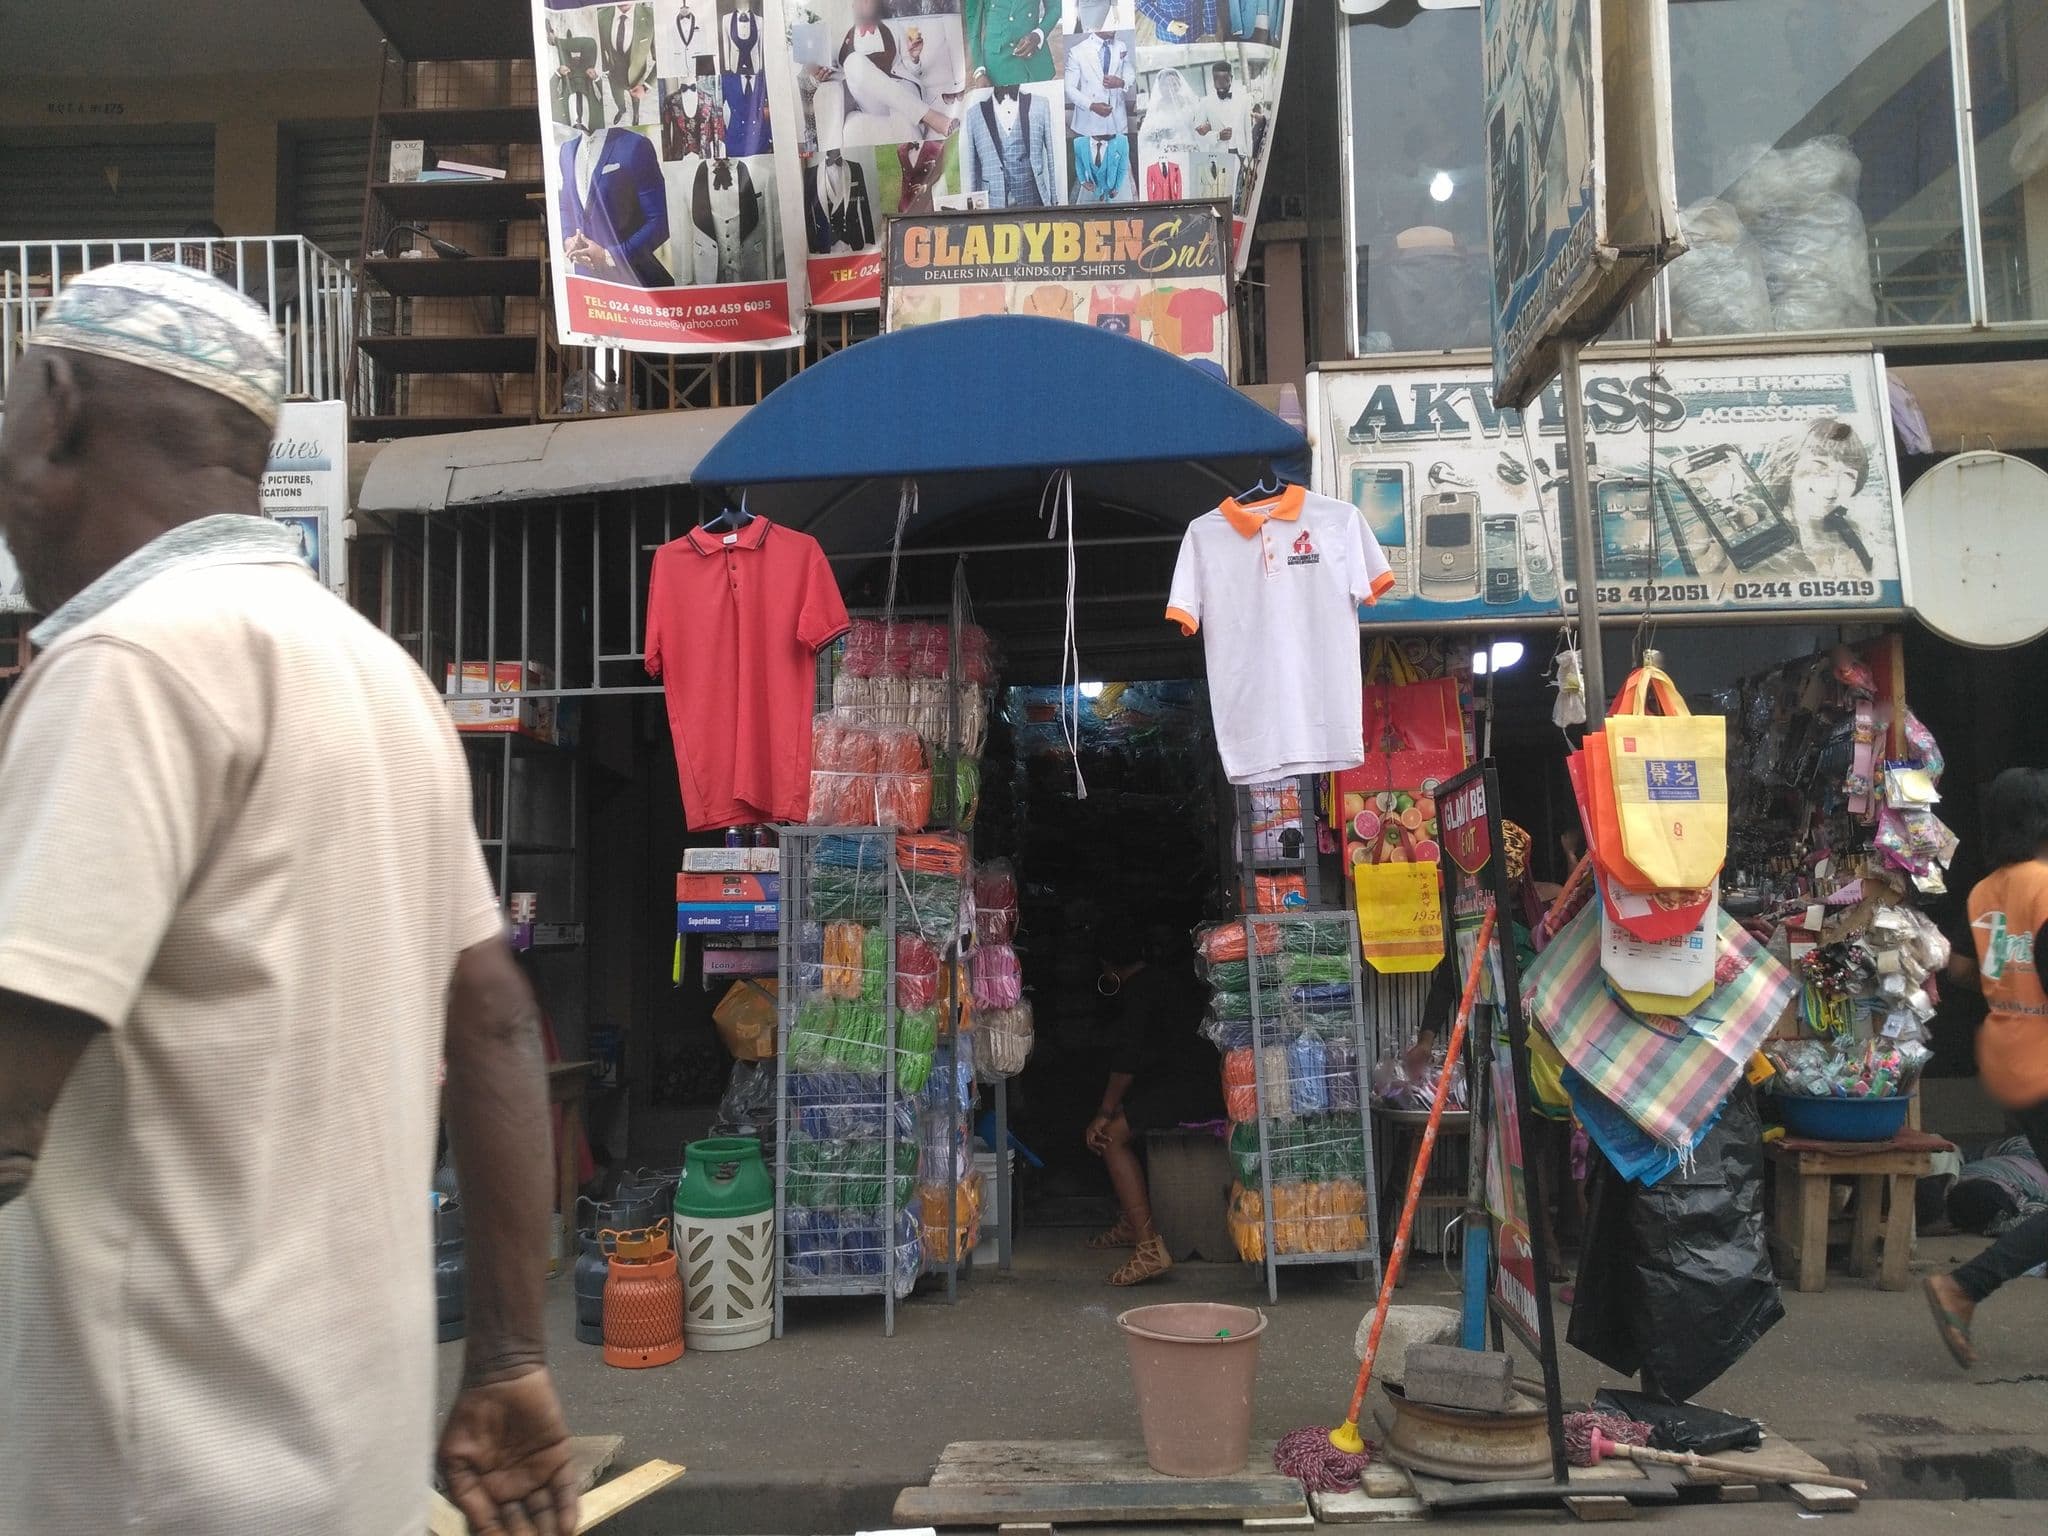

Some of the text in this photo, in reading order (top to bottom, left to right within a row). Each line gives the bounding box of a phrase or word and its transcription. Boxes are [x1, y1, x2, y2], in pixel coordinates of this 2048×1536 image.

[903, 219, 1144, 268] GLADYBEN
[830, 268, 857, 281] TEL:
[924, 264, 1126, 280] DEALERS IN ALL KINDS OF T-SHIRTS
[584, 295, 771, 317] TEL: 024 498 5878 / 024 459 6095
[588, 308, 739, 332] EMAIL: wastaee@yahoo.com
[1675, 374, 1848, 395] MOBILE PHONES
[1767, 391, 1784, 405] &
[1700, 404, 1840, 425] ACCESSORIES
[269, 438, 323, 459] ures
[268, 475, 313, 486] PICTURES,
[1565, 580, 1875, 604] 068 402051 / 0244 615419
